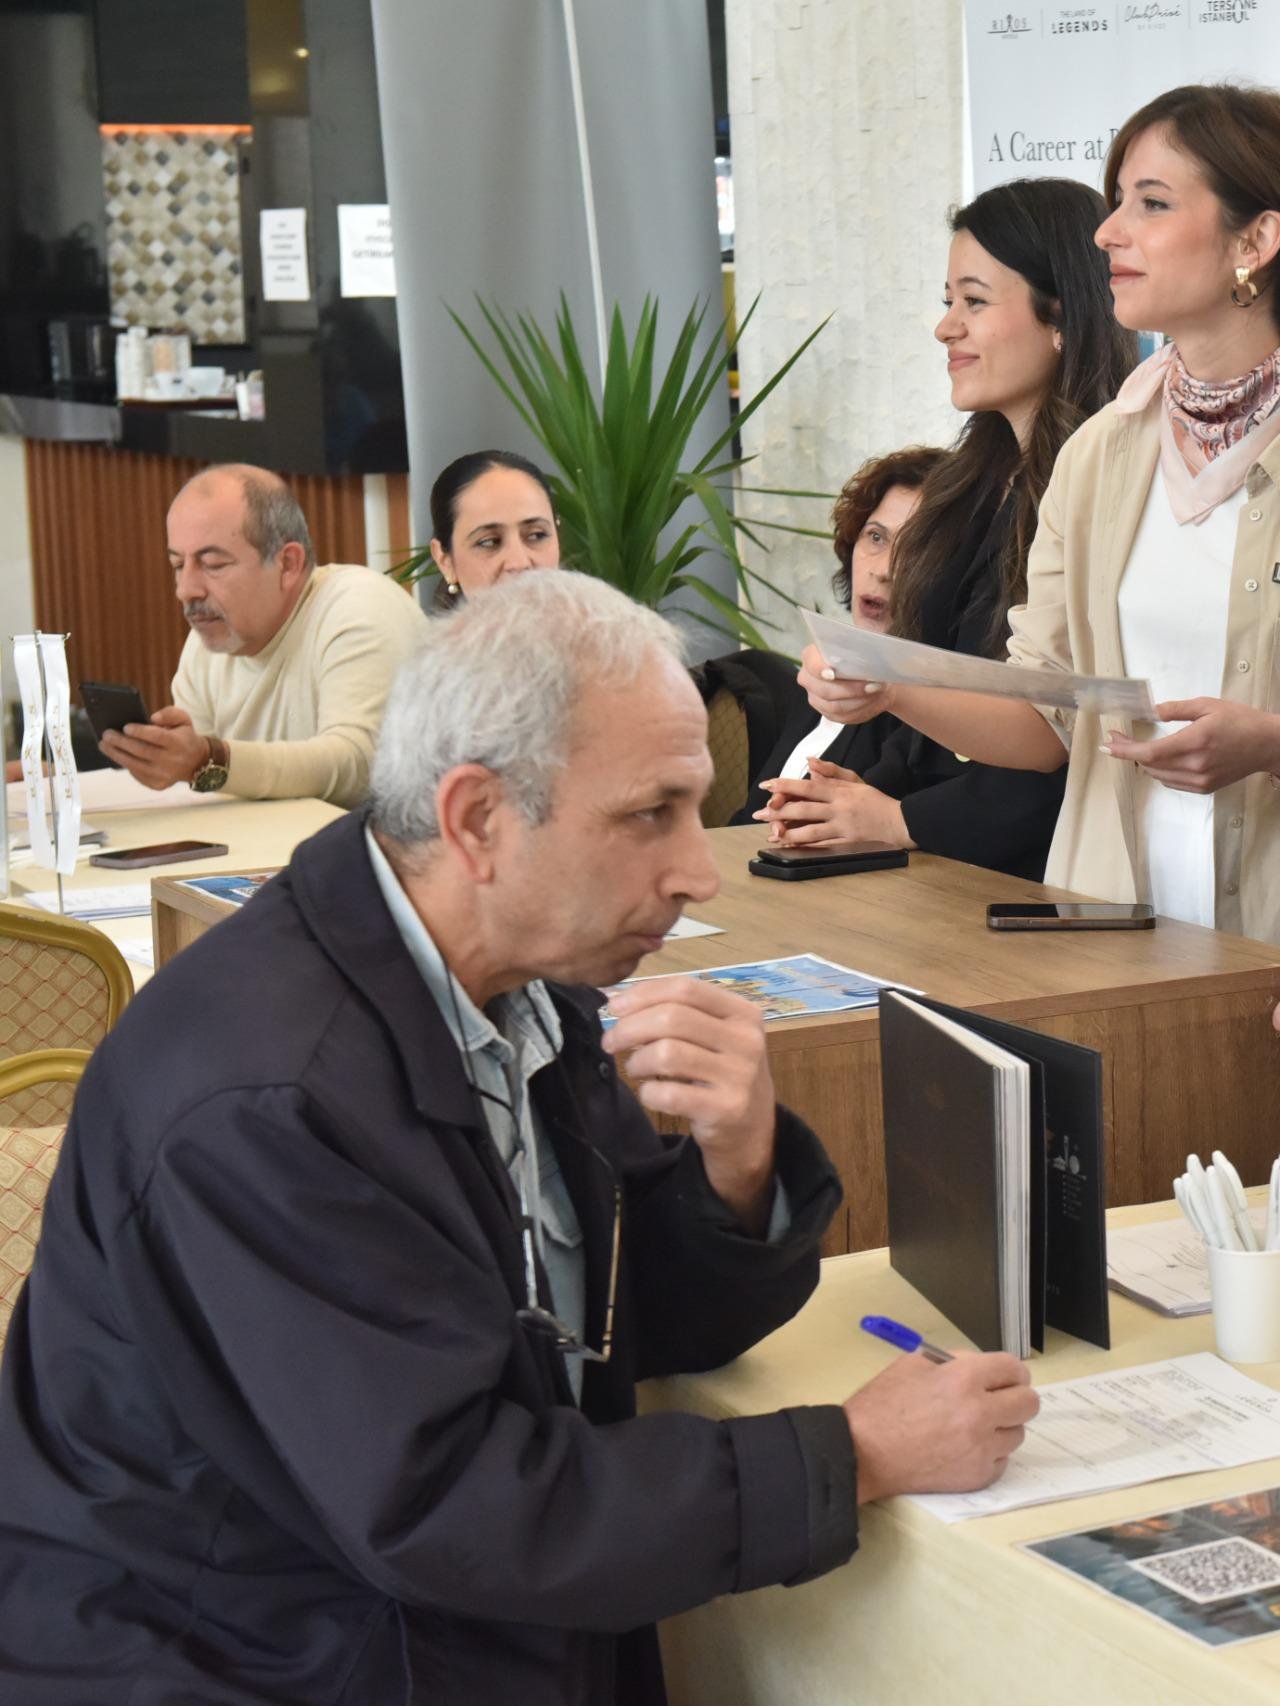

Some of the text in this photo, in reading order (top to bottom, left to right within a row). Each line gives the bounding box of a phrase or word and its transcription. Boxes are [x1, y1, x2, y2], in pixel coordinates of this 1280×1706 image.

[1051, 19, 1108, 34] LEGENDS
[988, 132, 1005, 162] A
[1010, 130, 1077, 162] Career
[1084, 137, 1104, 161] at
